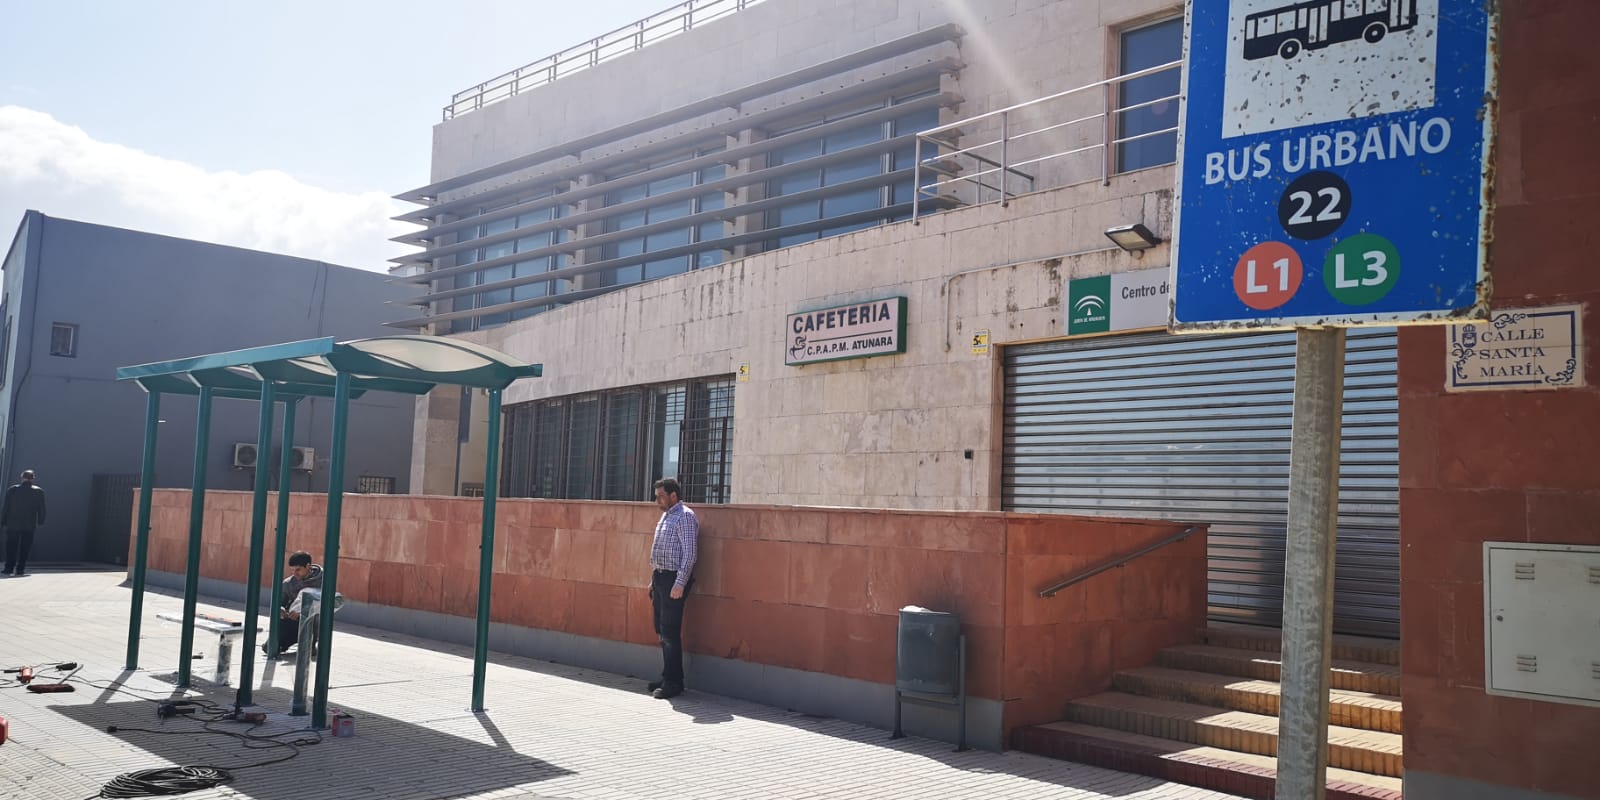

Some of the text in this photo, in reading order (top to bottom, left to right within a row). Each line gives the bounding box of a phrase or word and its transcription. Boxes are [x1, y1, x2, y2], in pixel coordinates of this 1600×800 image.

[1205, 117, 1452, 185] BUS URBANO
[1288, 187, 1342, 225] 22
[1245, 258, 1289, 293] L1
[1335, 250, 1388, 289] L3
[1121, 285, 1156, 300] Centro
[793, 302, 890, 334] CAFETERIA
[807, 336, 893, 356] C.P.A.P.M. ATUNARA
[1481, 328, 1545, 343] CALLE
[1479, 346, 1545, 360] SANTA
[1480, 362, 1546, 377] MARÍA
